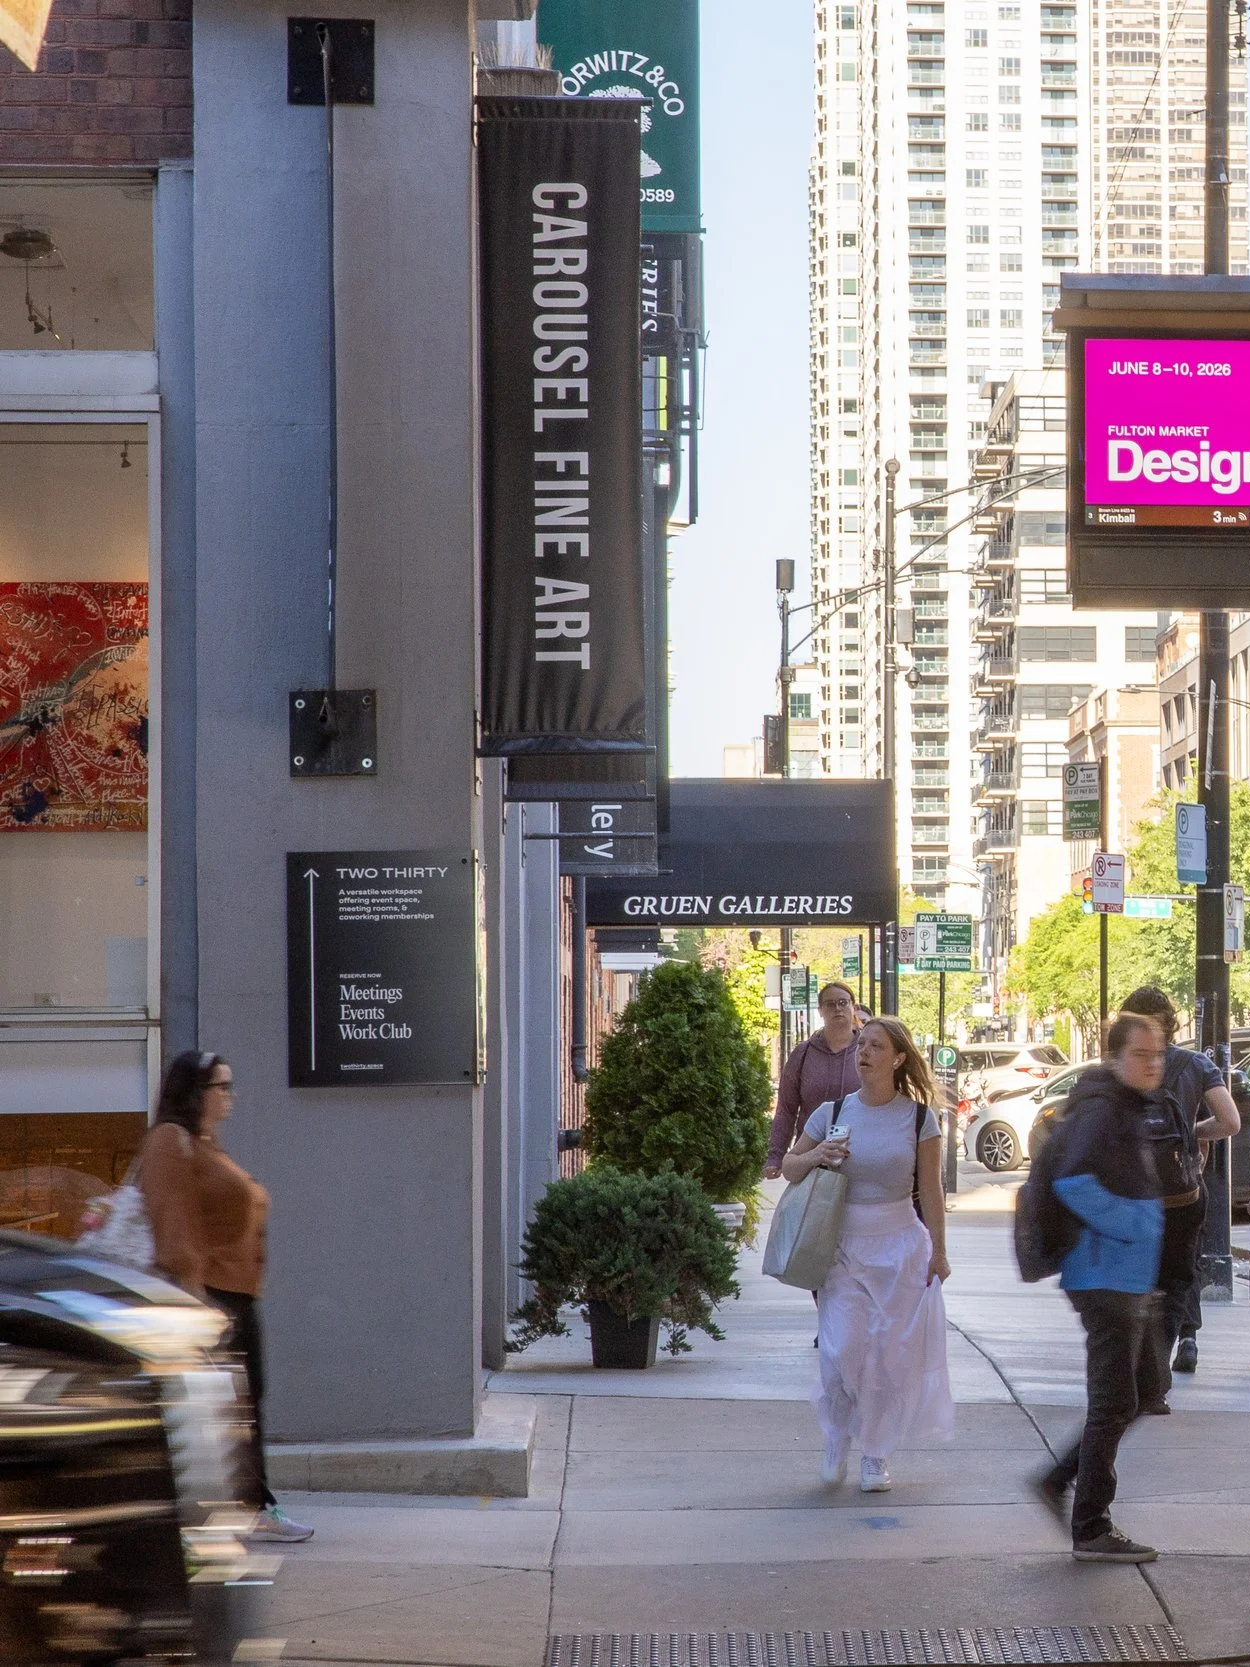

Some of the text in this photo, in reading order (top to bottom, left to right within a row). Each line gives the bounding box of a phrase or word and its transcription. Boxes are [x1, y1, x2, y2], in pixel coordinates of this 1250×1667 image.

[562, 50, 685, 116] ORWITZ&CO
[1108, 361, 1149, 376] JUNE
[1196, 362, 1232, 377] 2026
[532, 182, 591, 670] CAROUSEL FINE ART
[1108, 425, 1209, 437] FULTON MARKET
[1098, 514, 1135, 523] Kimball
[1213, 511, 1236, 523] 3 min
[336, 867, 448, 879] TWO THIRTY
[346, 888, 380, 896] versatile
[380, 888, 423, 897] workspace
[339, 897, 370, 905] offering
[623, 895, 853, 915] GRUEN GALLERIES
[339, 905, 371, 913] meeting
[1106, 904, 1122, 912] ZONE
[339, 912, 435, 922] coworking memberships
[947, 915, 968, 923] PARK
[921, 960, 932, 968] DAY
[932, 960, 945, 968] PAID
[946, 960, 970, 969] PARKING
[339, 983, 403, 1004] Meetings
[340, 1004, 385, 1020] Events
[338, 1022, 412, 1040] Work Club
